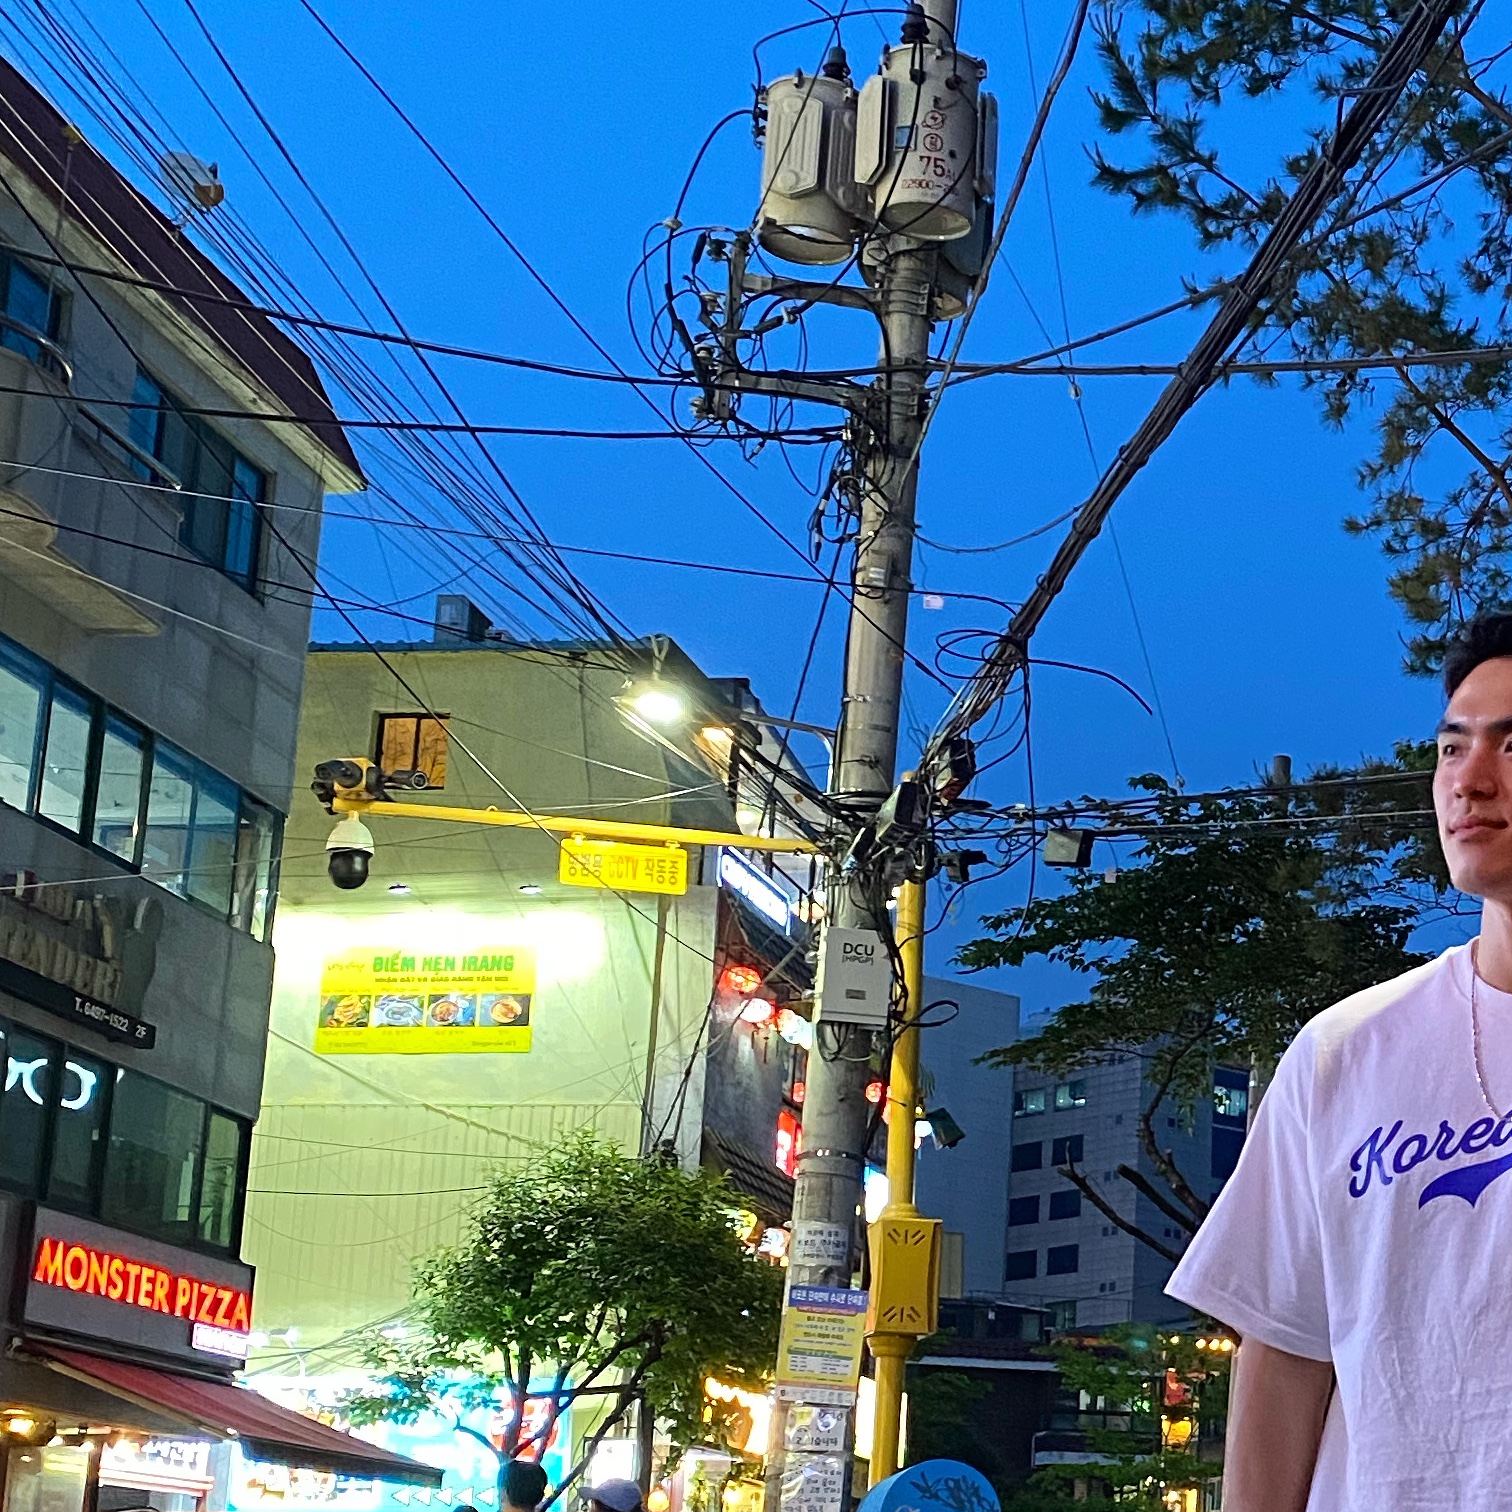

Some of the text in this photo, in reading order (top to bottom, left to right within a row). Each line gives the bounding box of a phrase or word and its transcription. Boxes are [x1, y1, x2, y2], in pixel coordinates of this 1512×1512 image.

[919, 156, 946, 177] 75
[608, 855, 639, 880] CCTV
[843, 942, 875, 956] DCU
[34, 1237, 250, 1332] MONSTER PIZZA
